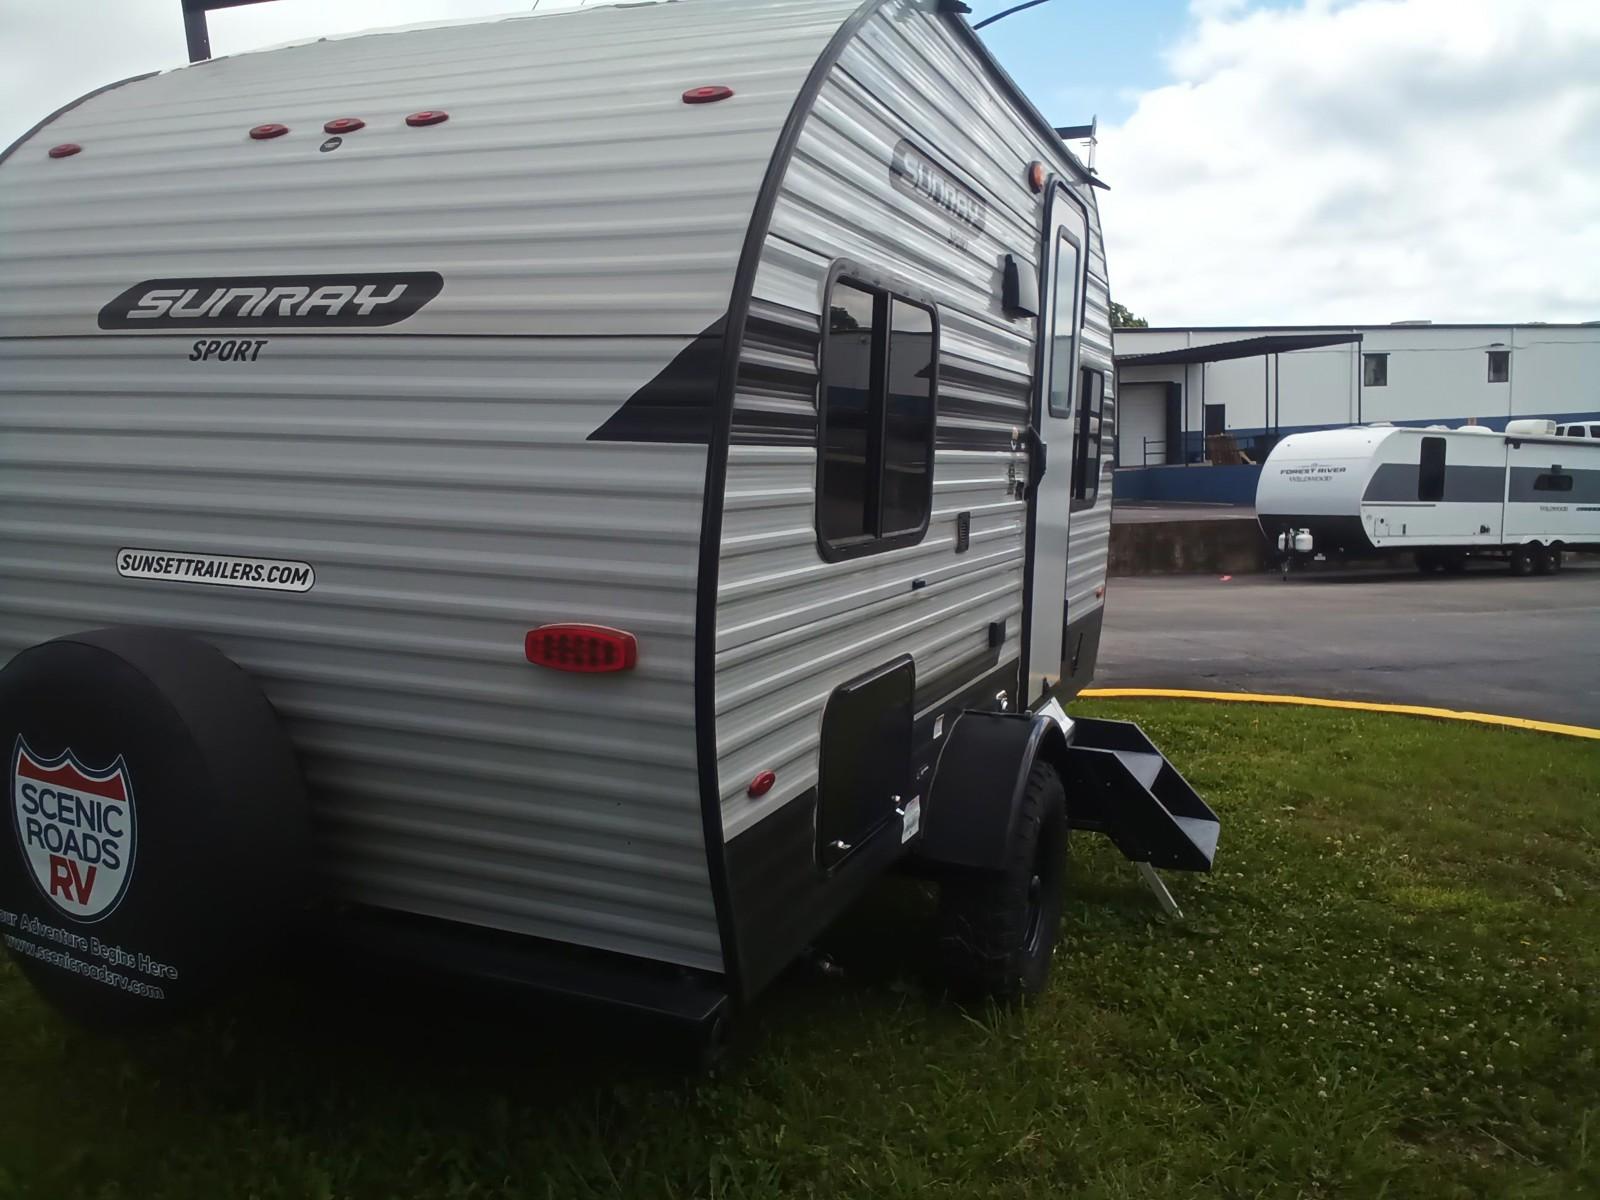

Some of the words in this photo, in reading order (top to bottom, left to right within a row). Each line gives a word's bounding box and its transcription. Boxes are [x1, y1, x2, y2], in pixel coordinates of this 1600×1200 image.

[126, 283, 408, 319] SUNRAY
[189, 340, 268, 362] SPORT
[120, 554, 309, 585] SUNSETTRAILERS.COM
[21, 783, 124, 838] SCENIC
[26, 816, 121, 871] ROADS
[49, 853, 97, 906] RV
[20, 913, 88, 951] Adventure
[90, 937, 136, 968] Begins
[138, 952, 178, 979] Here
